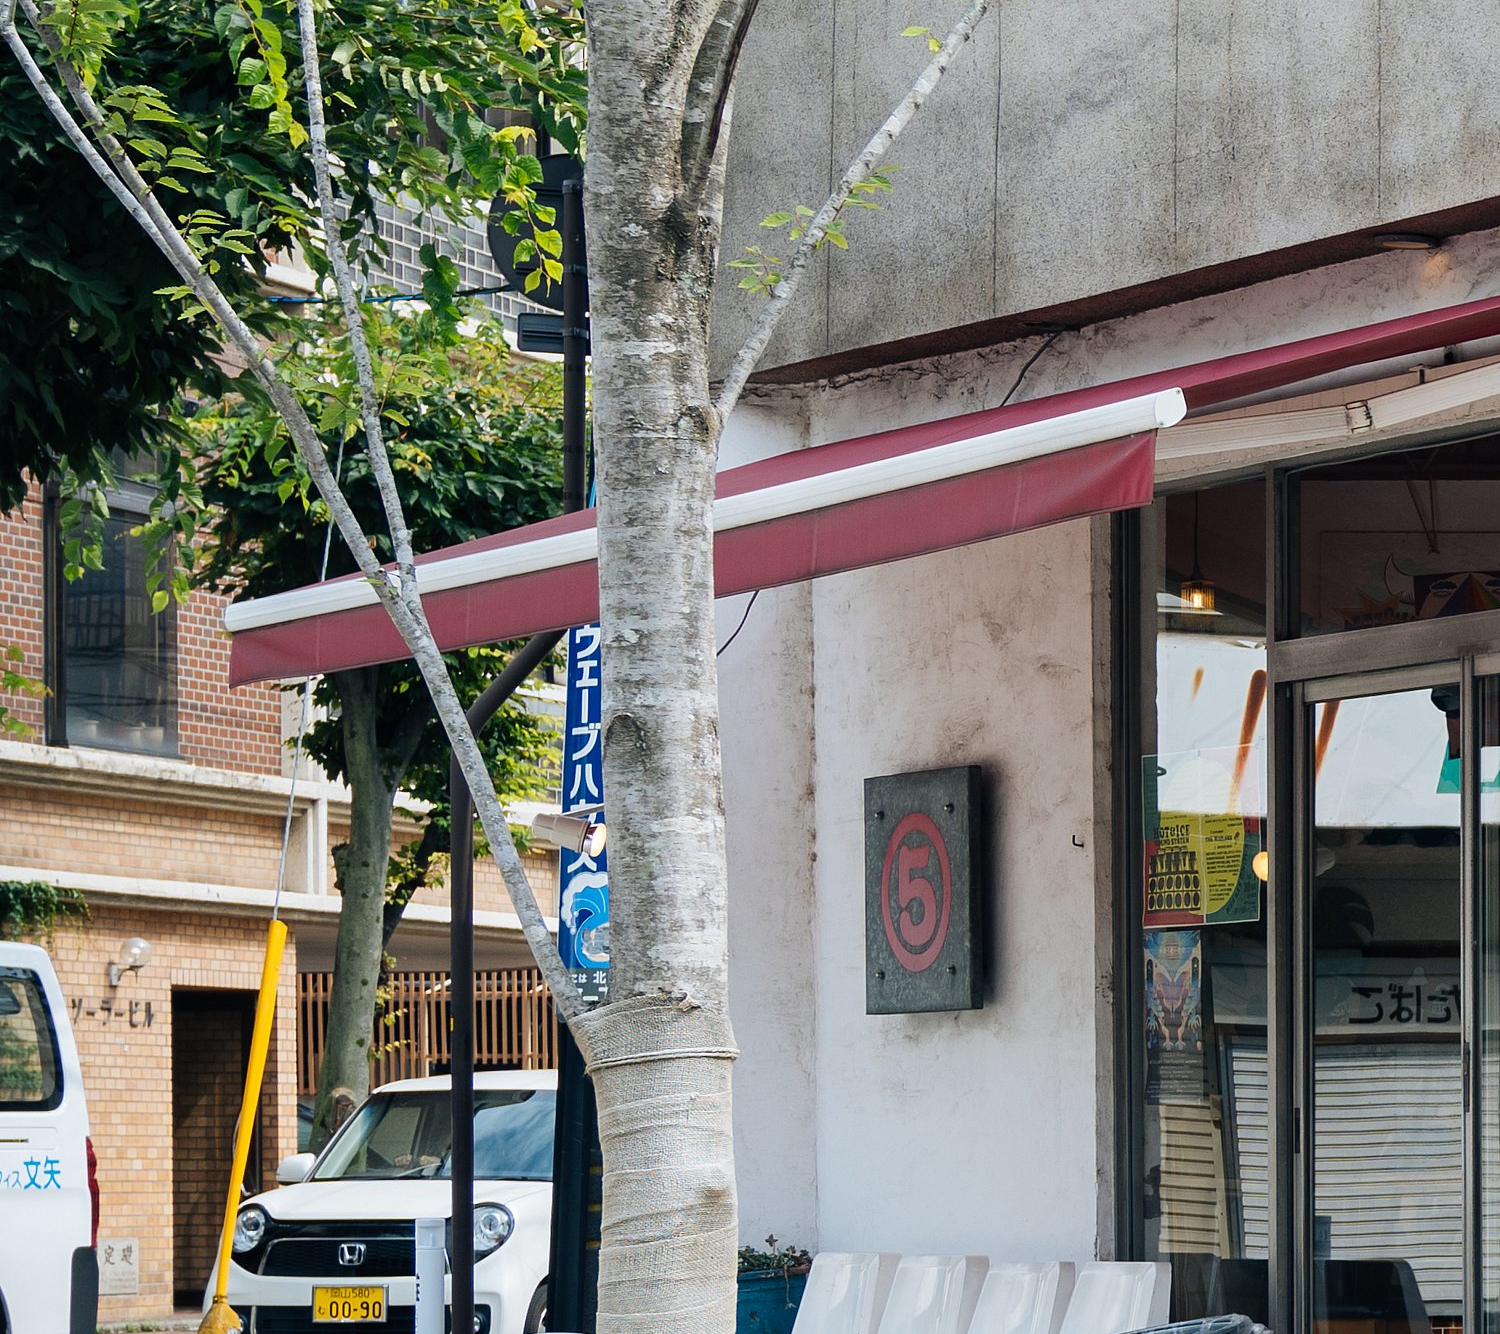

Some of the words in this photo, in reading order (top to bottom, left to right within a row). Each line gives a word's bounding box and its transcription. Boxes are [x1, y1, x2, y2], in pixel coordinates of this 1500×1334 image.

[899, 843, 938, 948] 5
[71, 998, 155, 1028] ソーラービル
[104, 1244, 134, 1267] 定礎
[329, 1300, 382, 1319] 00-90
